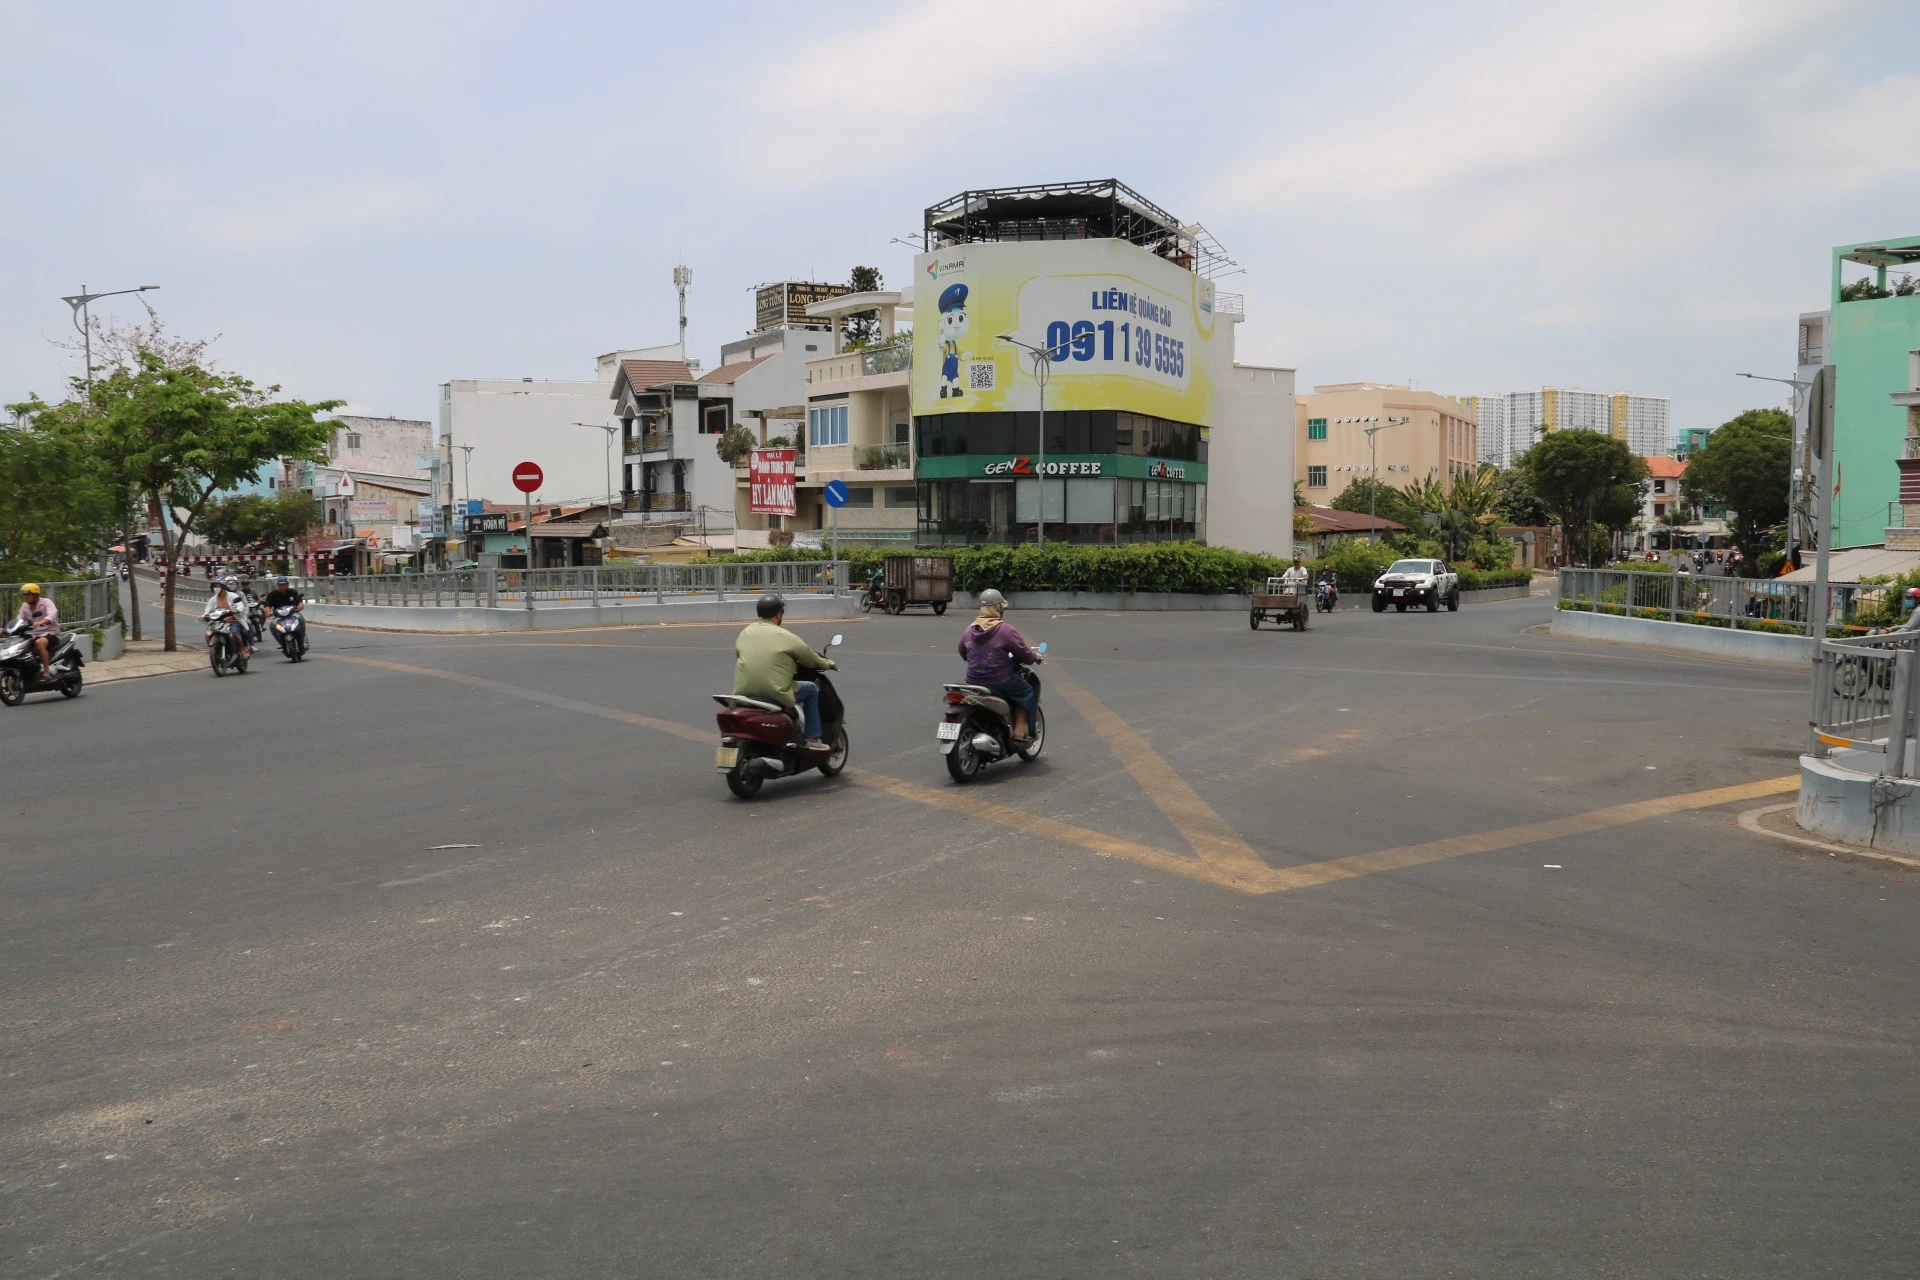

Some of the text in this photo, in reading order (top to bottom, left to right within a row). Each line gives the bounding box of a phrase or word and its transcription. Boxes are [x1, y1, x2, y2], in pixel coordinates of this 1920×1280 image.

[939, 260, 964, 272] VINAMA
[757, 298, 768, 311] LONG
[789, 294, 813, 304] LONG
[1092, 287, 1171, 327] LIÊN HỆ QUẢNG CÁO
[1047, 320, 1184, 378] 0911 39 5555
[1036, 462, 1100, 475] COFFEE
[1166, 465, 1185, 479] COFFEE
[777, 477, 794, 506] MÔN
